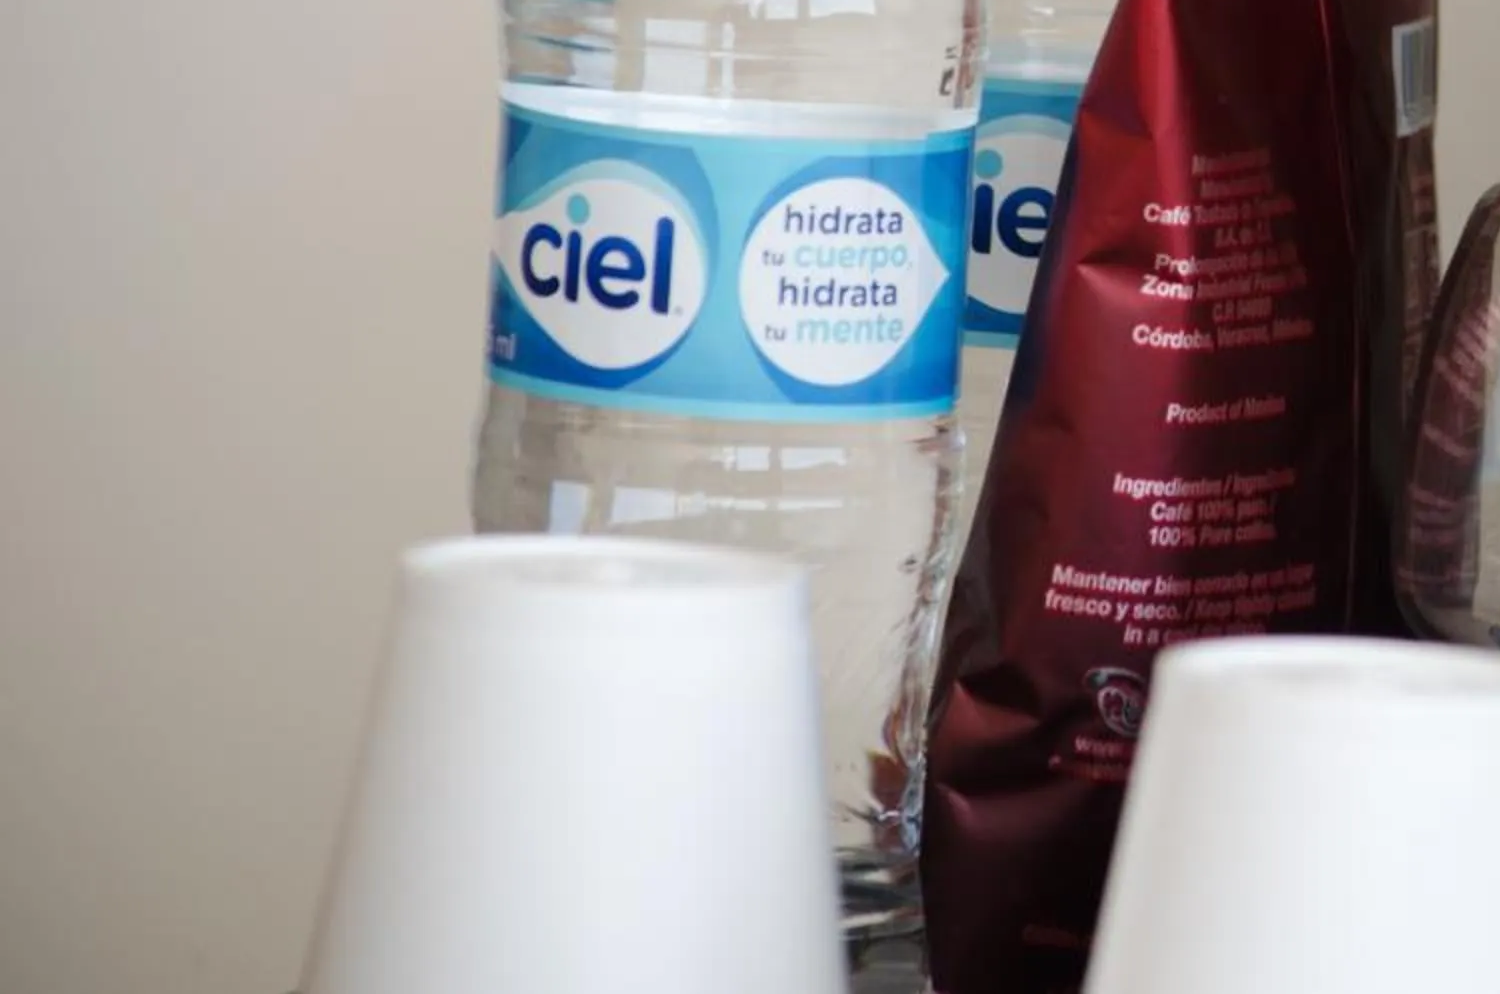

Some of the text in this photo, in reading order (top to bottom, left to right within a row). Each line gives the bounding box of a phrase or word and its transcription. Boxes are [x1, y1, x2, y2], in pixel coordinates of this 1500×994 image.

[972, 149, 1058, 258] ie
[1143, 202, 1192, 227] Café
[784, 205, 904, 235] hidrata
[520, 193, 676, 317] ciel
[762, 249, 786, 267] tu
[778, 276, 898, 307] hidrata
[764, 314, 904, 344] tu mente
[1166, 402, 1227, 425] Product
[1150, 501, 1192, 522] Café
[1149, 525, 1196, 547] 100%
[1051, 563, 1152, 596] Mantener
[1044, 588, 1113, 617] fresco
[1115, 601, 1130, 623] y
